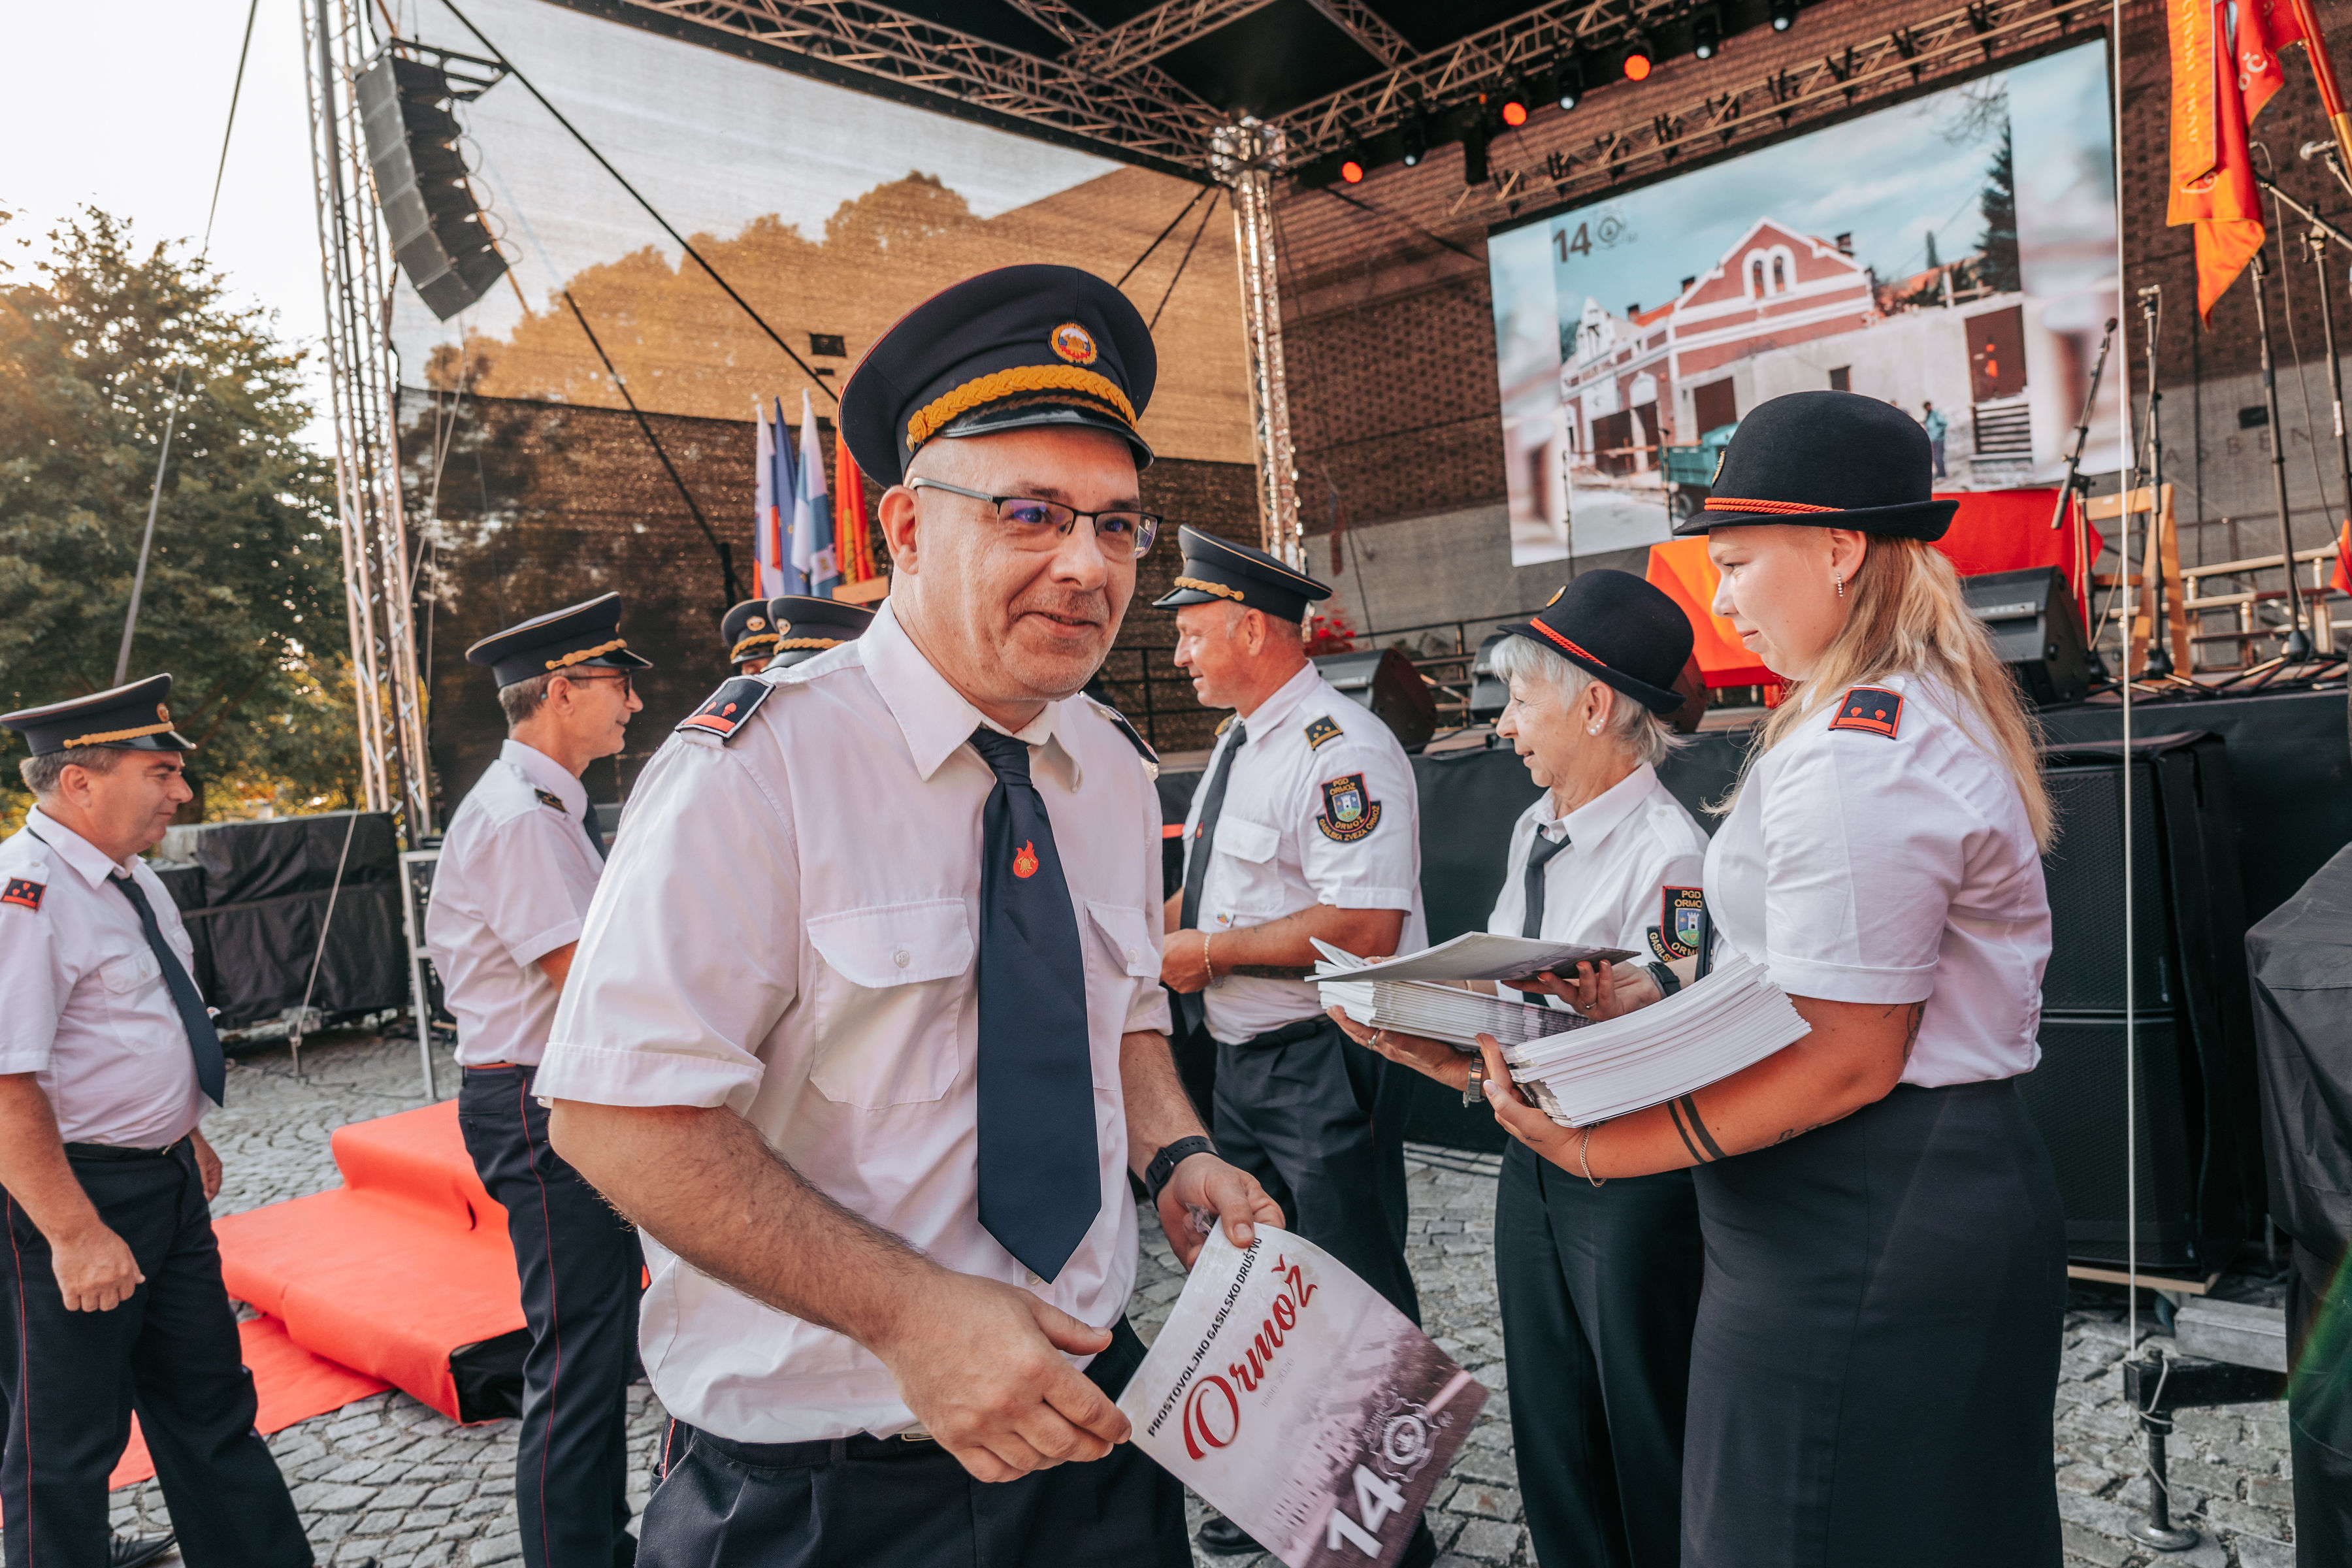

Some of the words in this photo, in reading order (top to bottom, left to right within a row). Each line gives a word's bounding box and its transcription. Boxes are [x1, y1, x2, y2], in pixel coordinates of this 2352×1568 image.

[1333, 777, 1348, 787] PGD
[1344, 828, 1368, 841] ZVEZA
[1681, 890, 1701, 899] PGD
[1674, 899, 1703, 908] ORMO
[1649, 932, 1676, 962] GASILS
[1671, 942, 1698, 956] ORM
[1147, 1339, 1211, 1437] PROSTOVOLJNO
[1207, 1283, 1241, 1340] GASILSKO
[1183, 1254, 1318, 1461] Ormož
